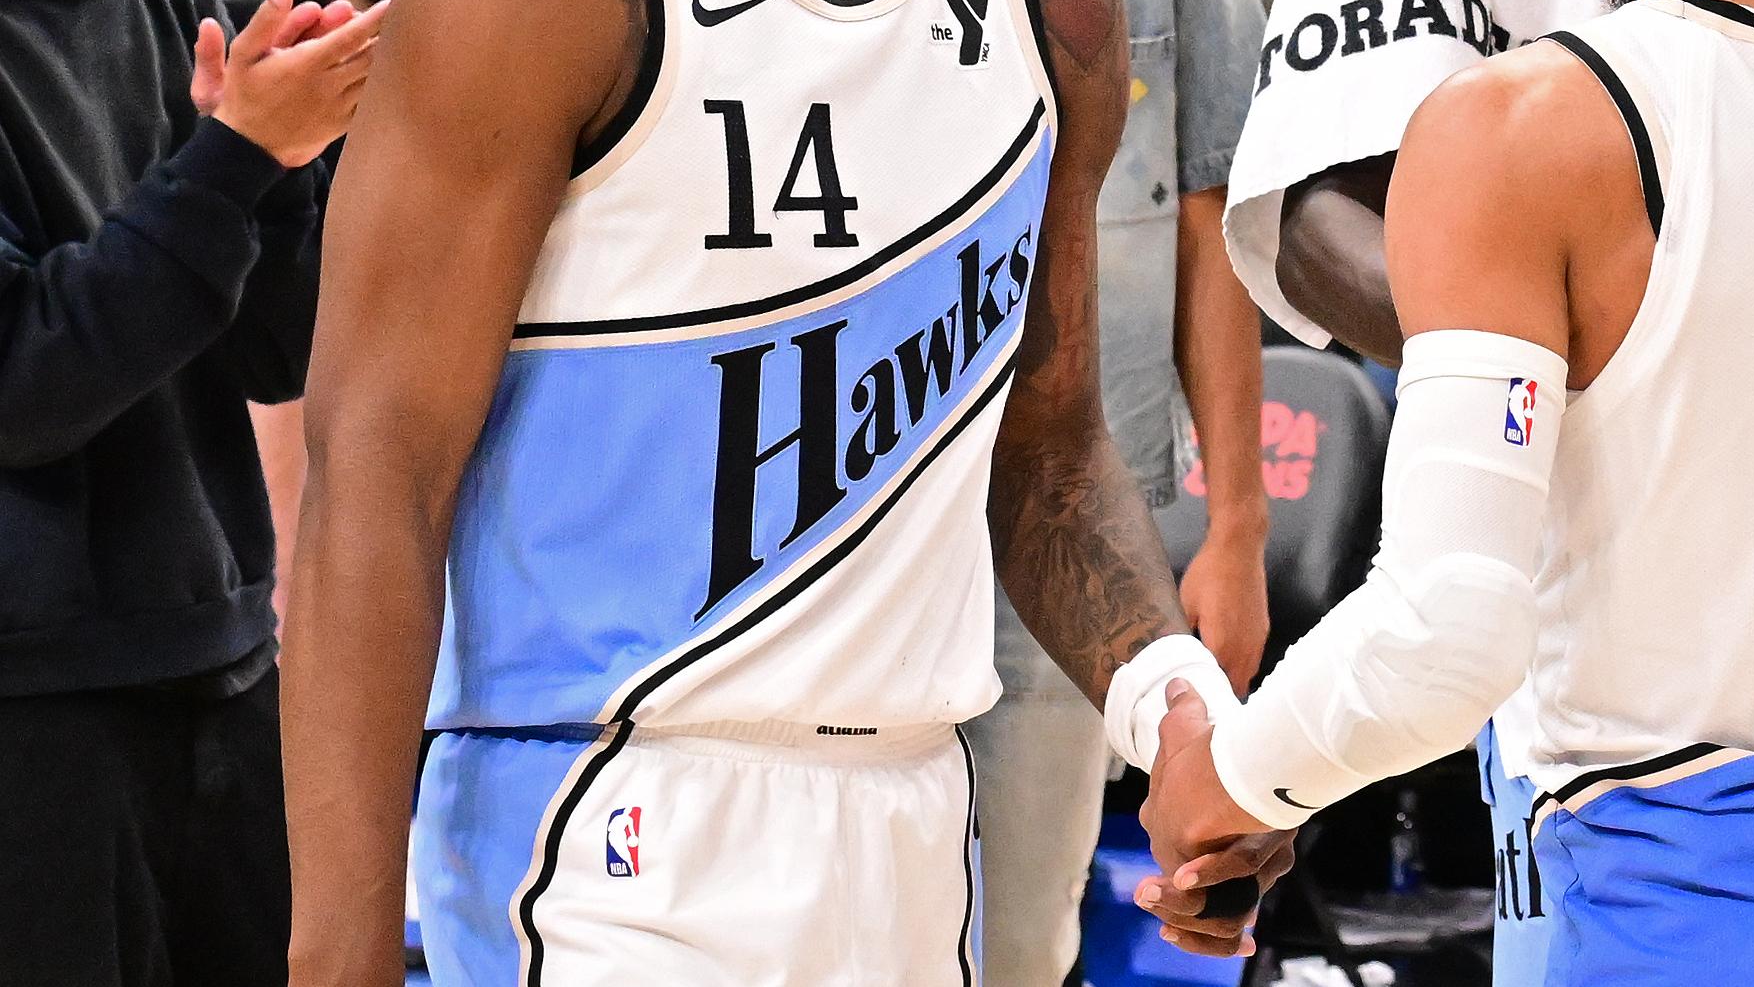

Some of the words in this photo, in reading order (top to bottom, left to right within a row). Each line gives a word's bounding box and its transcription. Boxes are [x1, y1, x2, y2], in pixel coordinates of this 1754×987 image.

[931, 23, 954, 41] the
[704, 99, 859, 249] 14
[693, 227, 1032, 623] Hawks
[610, 862, 628, 875] NBA
